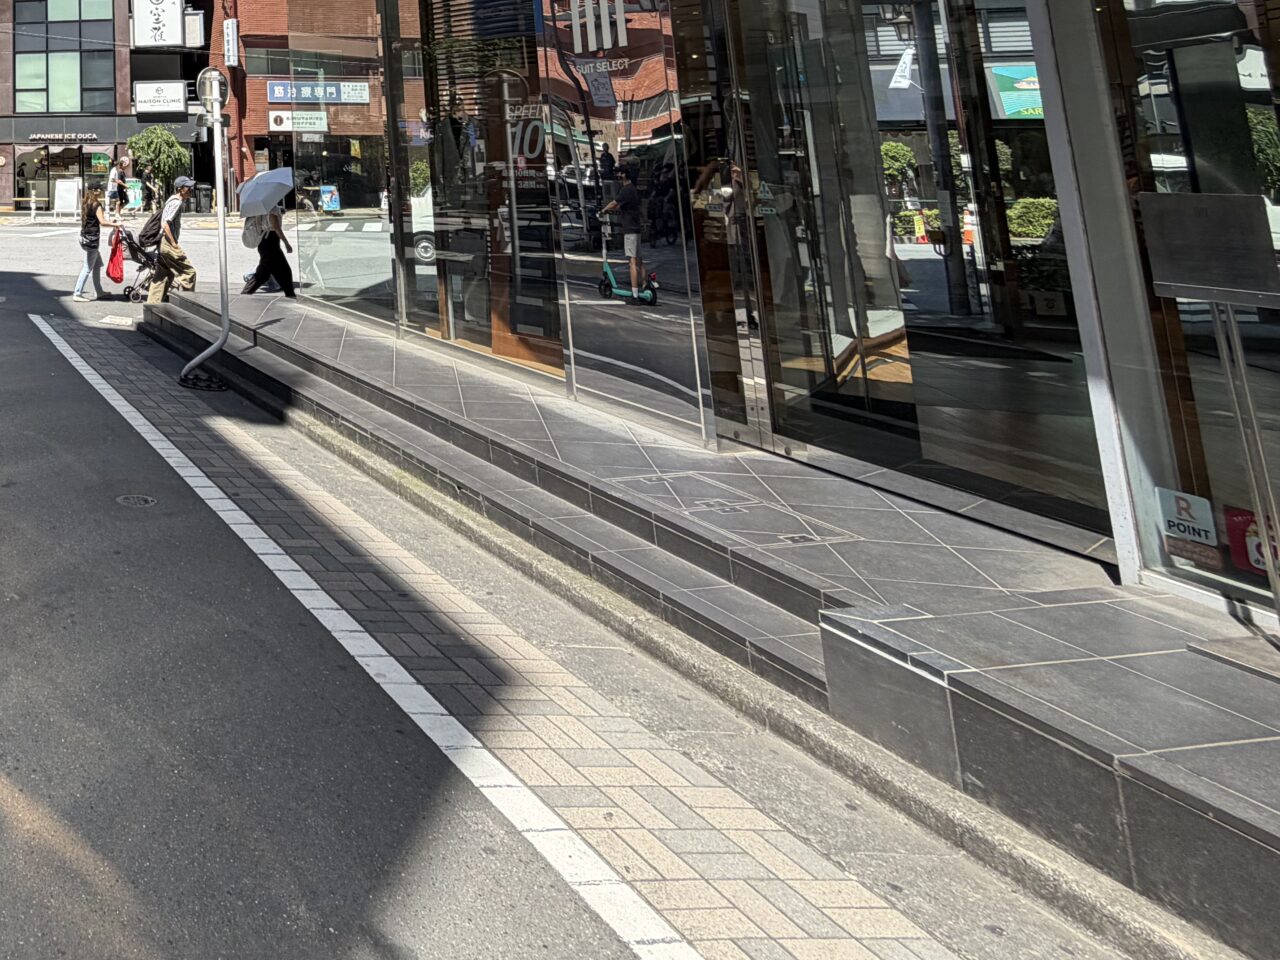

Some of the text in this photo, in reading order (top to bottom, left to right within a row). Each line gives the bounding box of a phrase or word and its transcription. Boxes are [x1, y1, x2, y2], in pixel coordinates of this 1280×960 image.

[576, 58, 630, 74] SUIT SELECT
[1167, 520, 1211, 540] POINT
